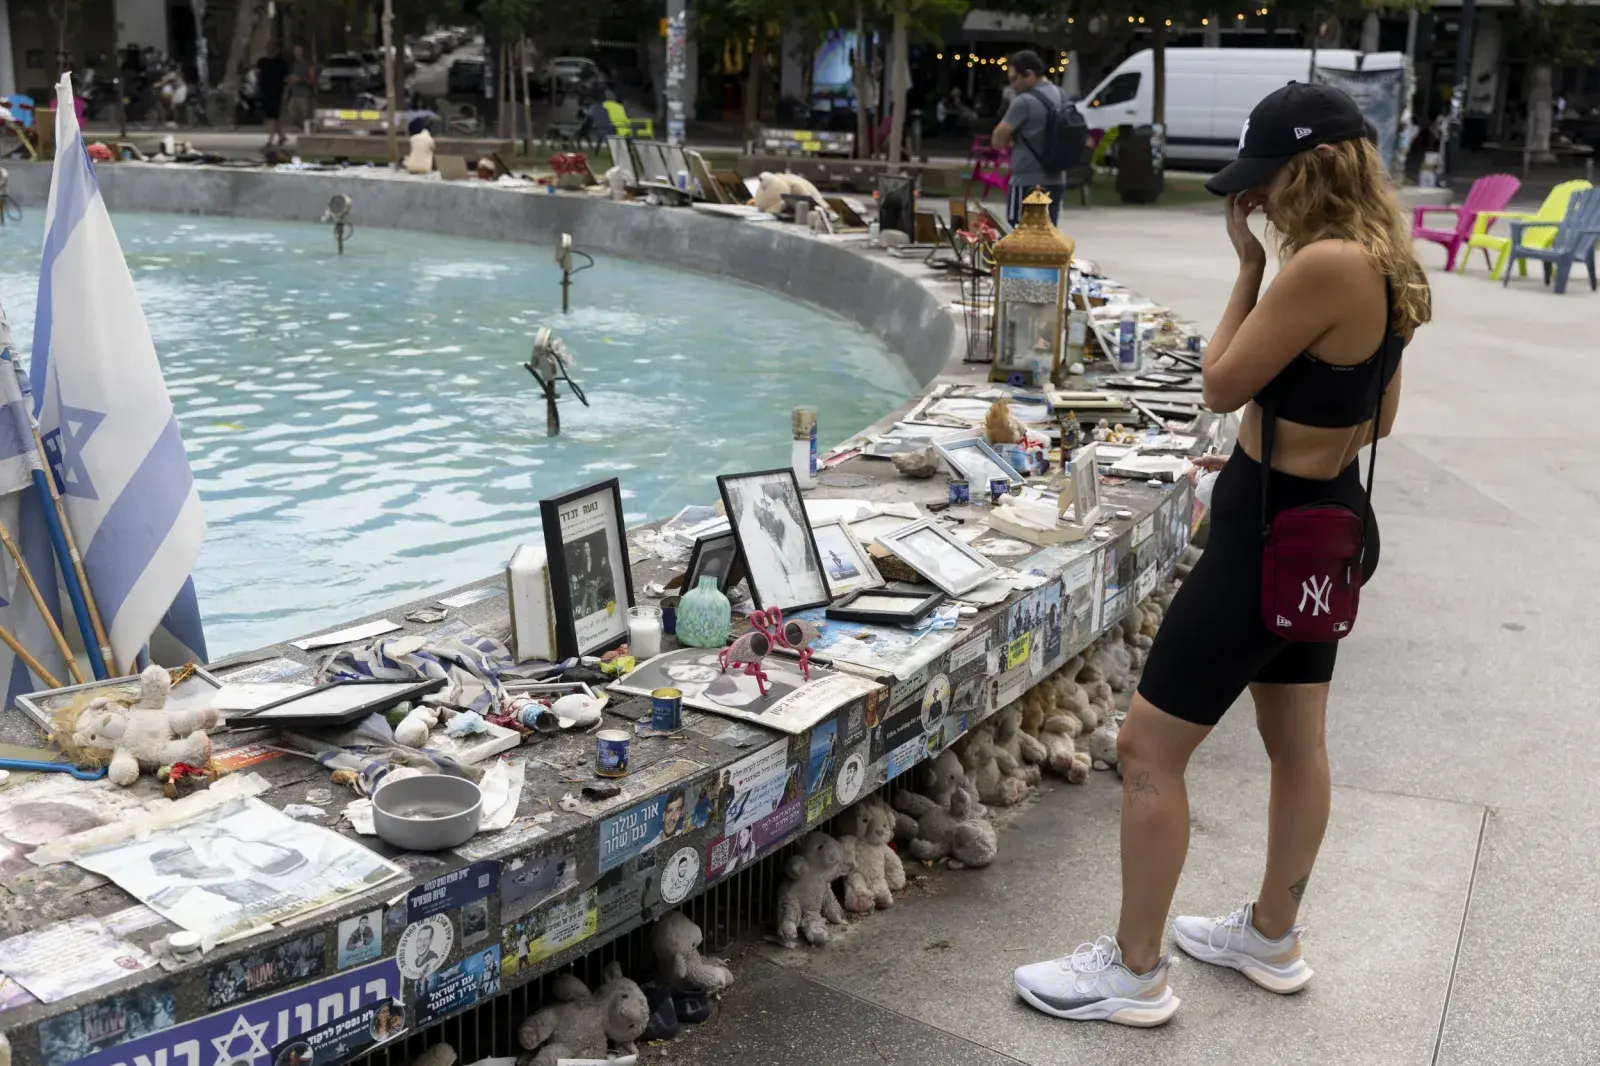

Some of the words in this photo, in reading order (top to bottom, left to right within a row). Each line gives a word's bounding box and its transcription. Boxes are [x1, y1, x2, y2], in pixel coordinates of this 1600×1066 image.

[560, 510, 578, 523] זנדר
[583, 501, 598, 515] נועה
[641, 803, 658, 820] אור
[612, 812, 637, 836] עולה
[632, 823, 647, 842] עם
[604, 833, 628, 854] שחר
[462, 974, 474, 986] עם
[430, 981, 459, 1001] ישראל
[458, 982, 478, 998] צריך
[362, 1010, 374, 1022] לא
[336, 1016, 360, 1036] נפסיק
[307, 1026, 334, 1046] לרקוד
